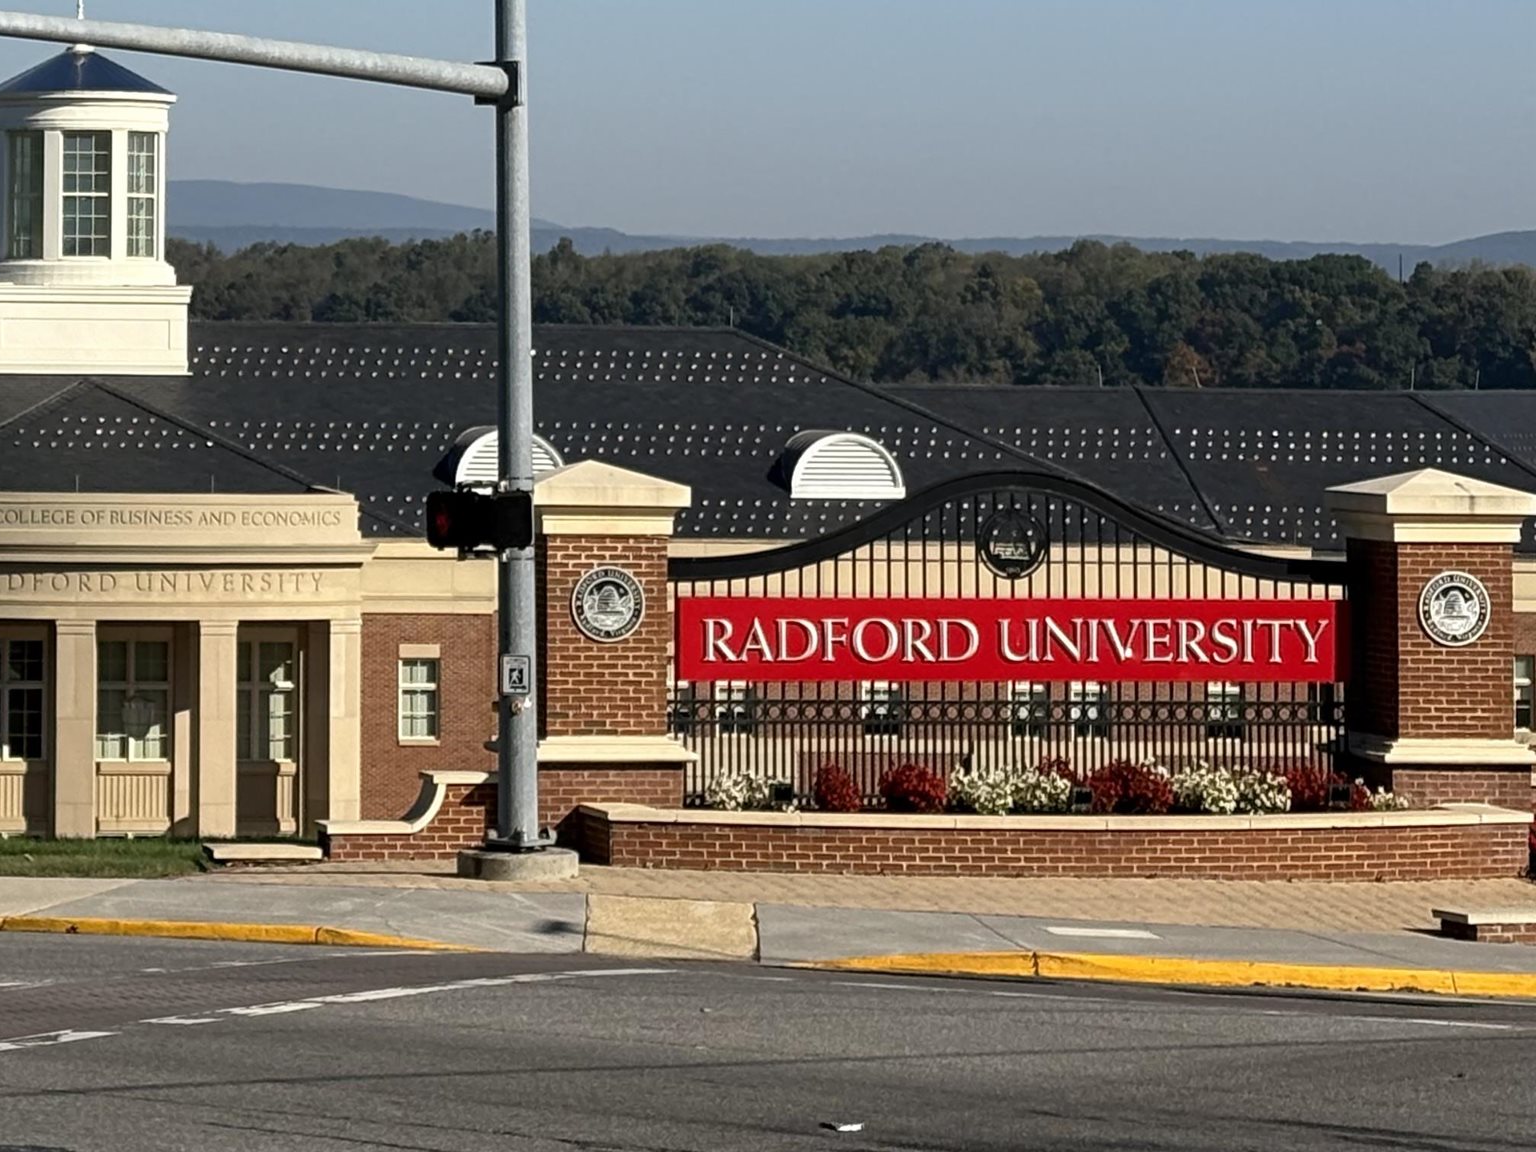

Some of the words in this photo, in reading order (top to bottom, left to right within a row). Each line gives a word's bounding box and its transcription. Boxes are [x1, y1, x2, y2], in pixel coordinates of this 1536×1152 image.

[80, 509, 106, 525] OF
[110, 509, 193, 526] BUSINESS
[198, 510, 236, 526] AND
[241, 511, 341, 527] ECONOMICS
[135, 572, 324, 593] UNIVERSITY
[701, 616, 980, 663] RADFORD
[997, 615, 1330, 663] UNIVERSITY
